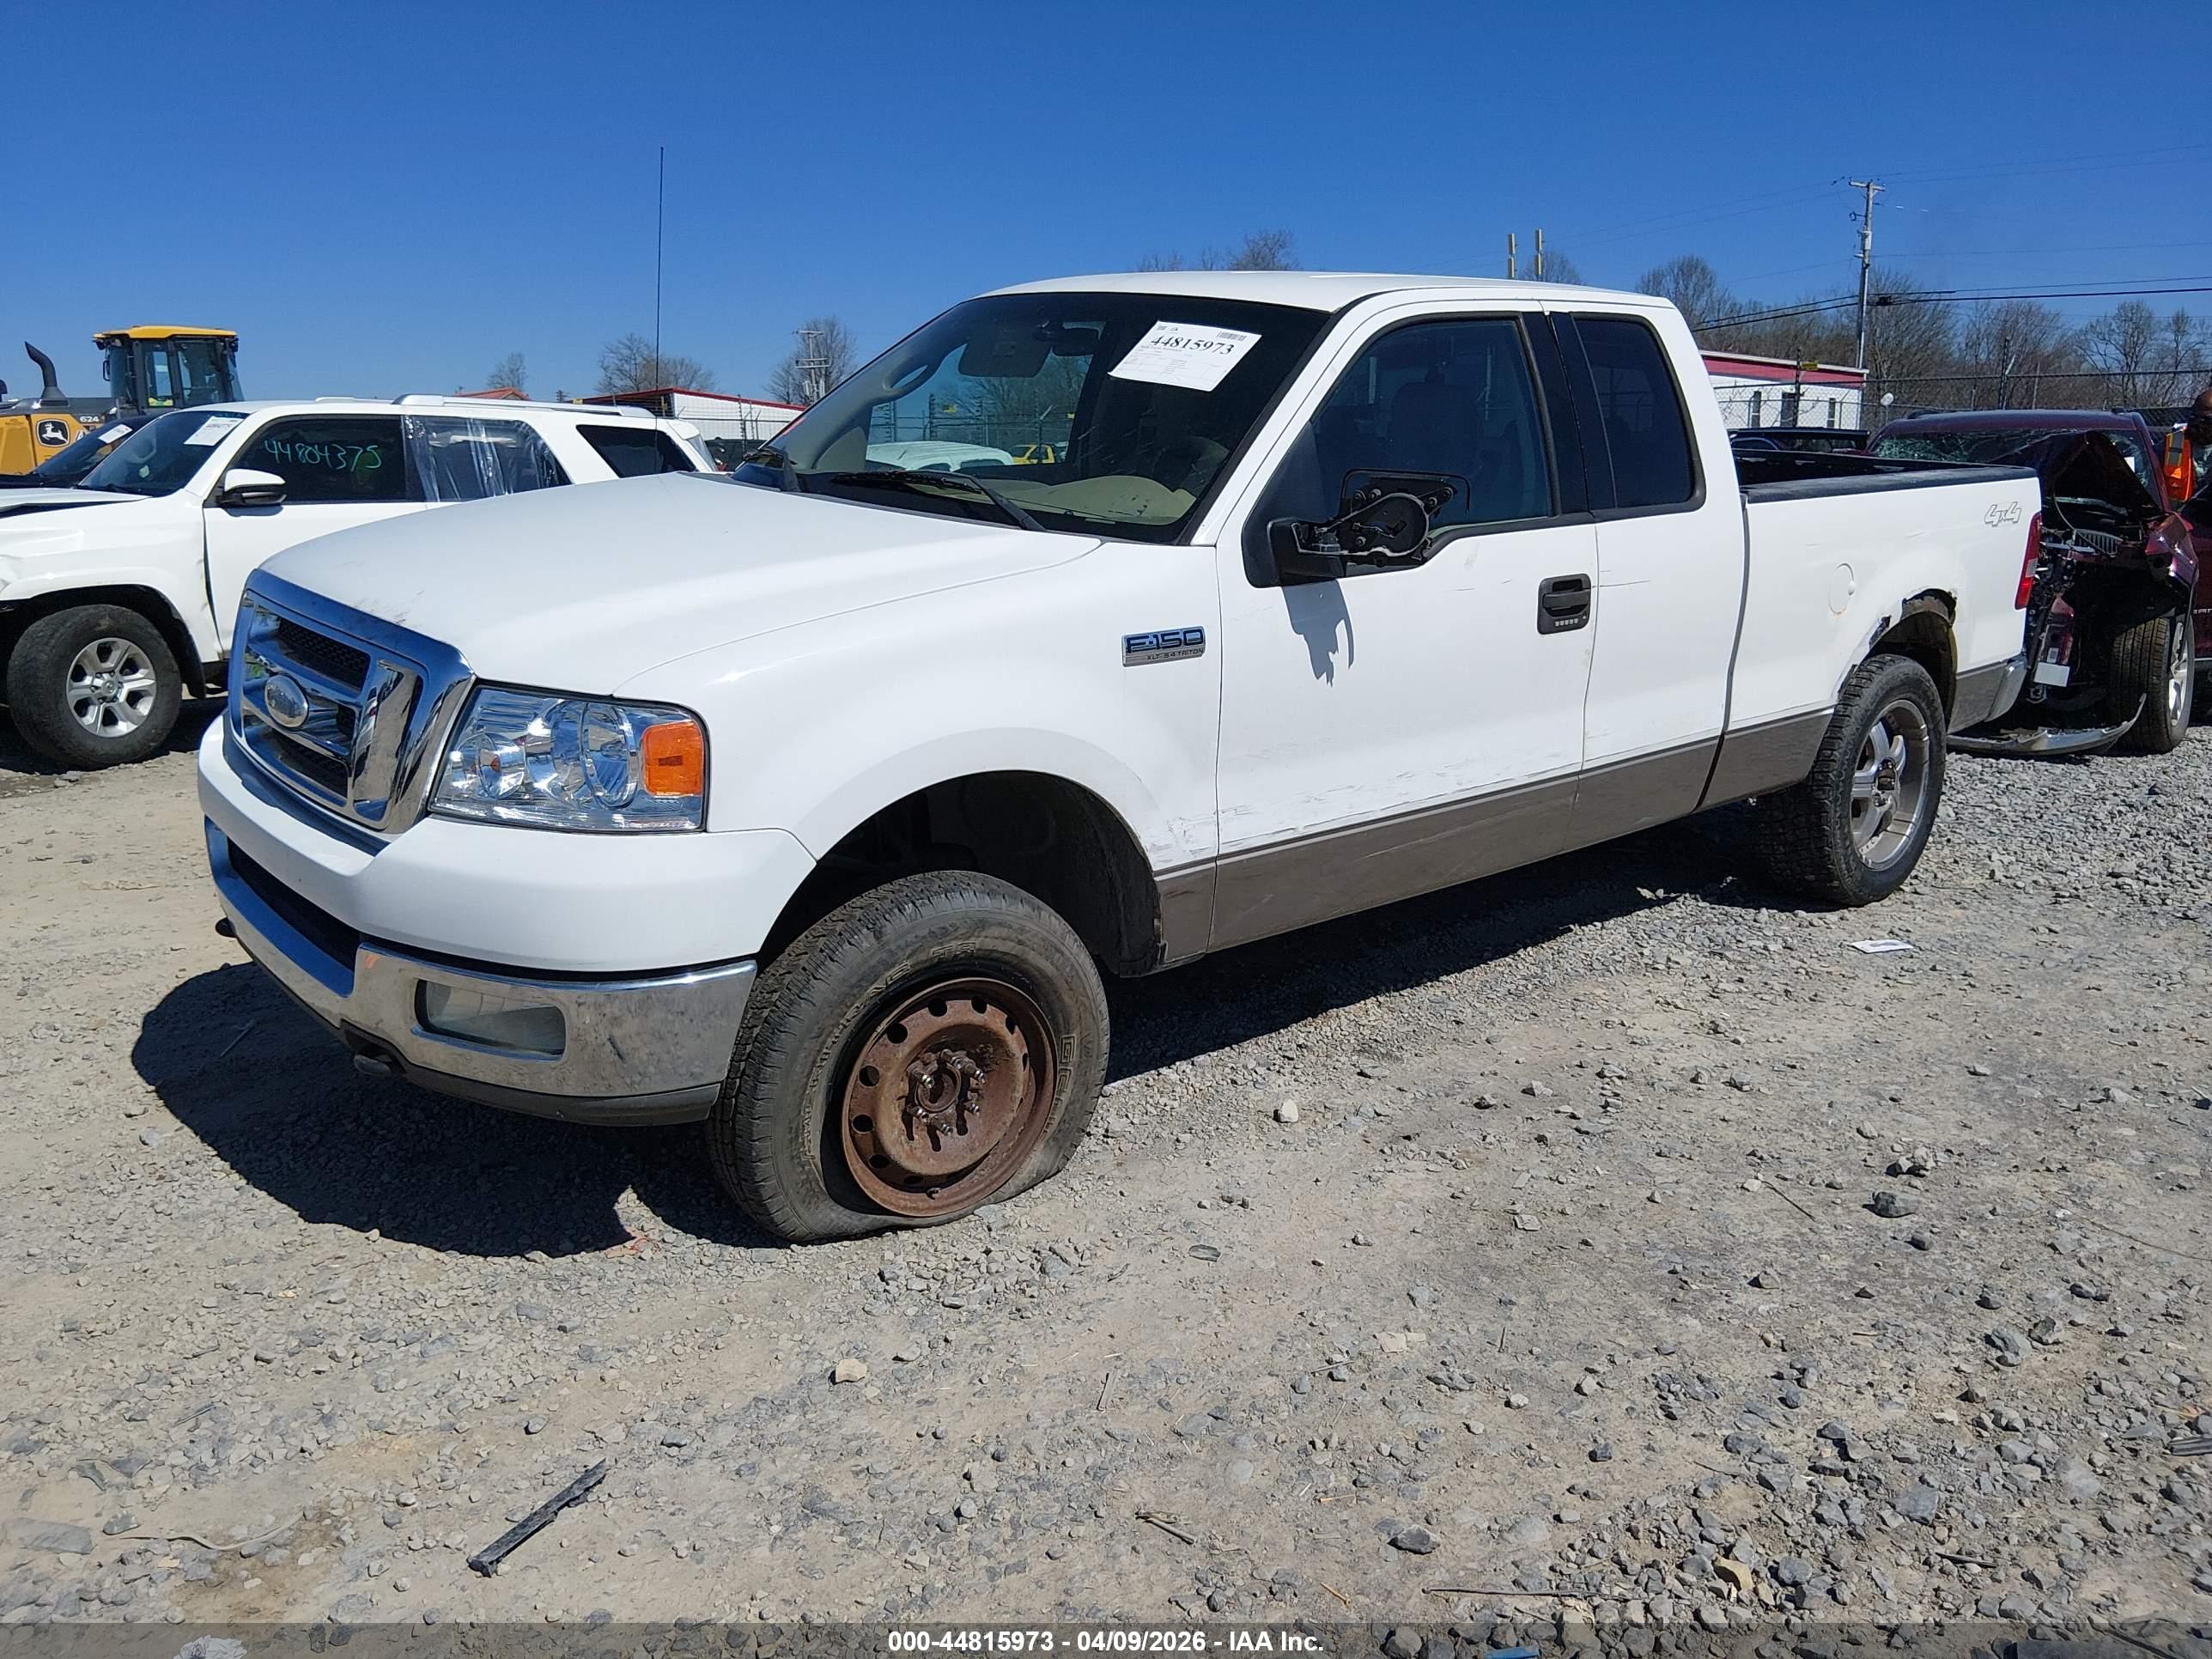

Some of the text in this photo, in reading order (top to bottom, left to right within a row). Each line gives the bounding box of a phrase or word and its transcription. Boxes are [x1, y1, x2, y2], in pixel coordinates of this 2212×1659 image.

[1151, 335, 1235, 355] 44815973
[264, 440, 382, 471] 44804375
[1984, 501, 2021, 526] 4x4
[1126, 629, 1204, 653] F-150
[1178, 647, 1204, 656] TRITON
